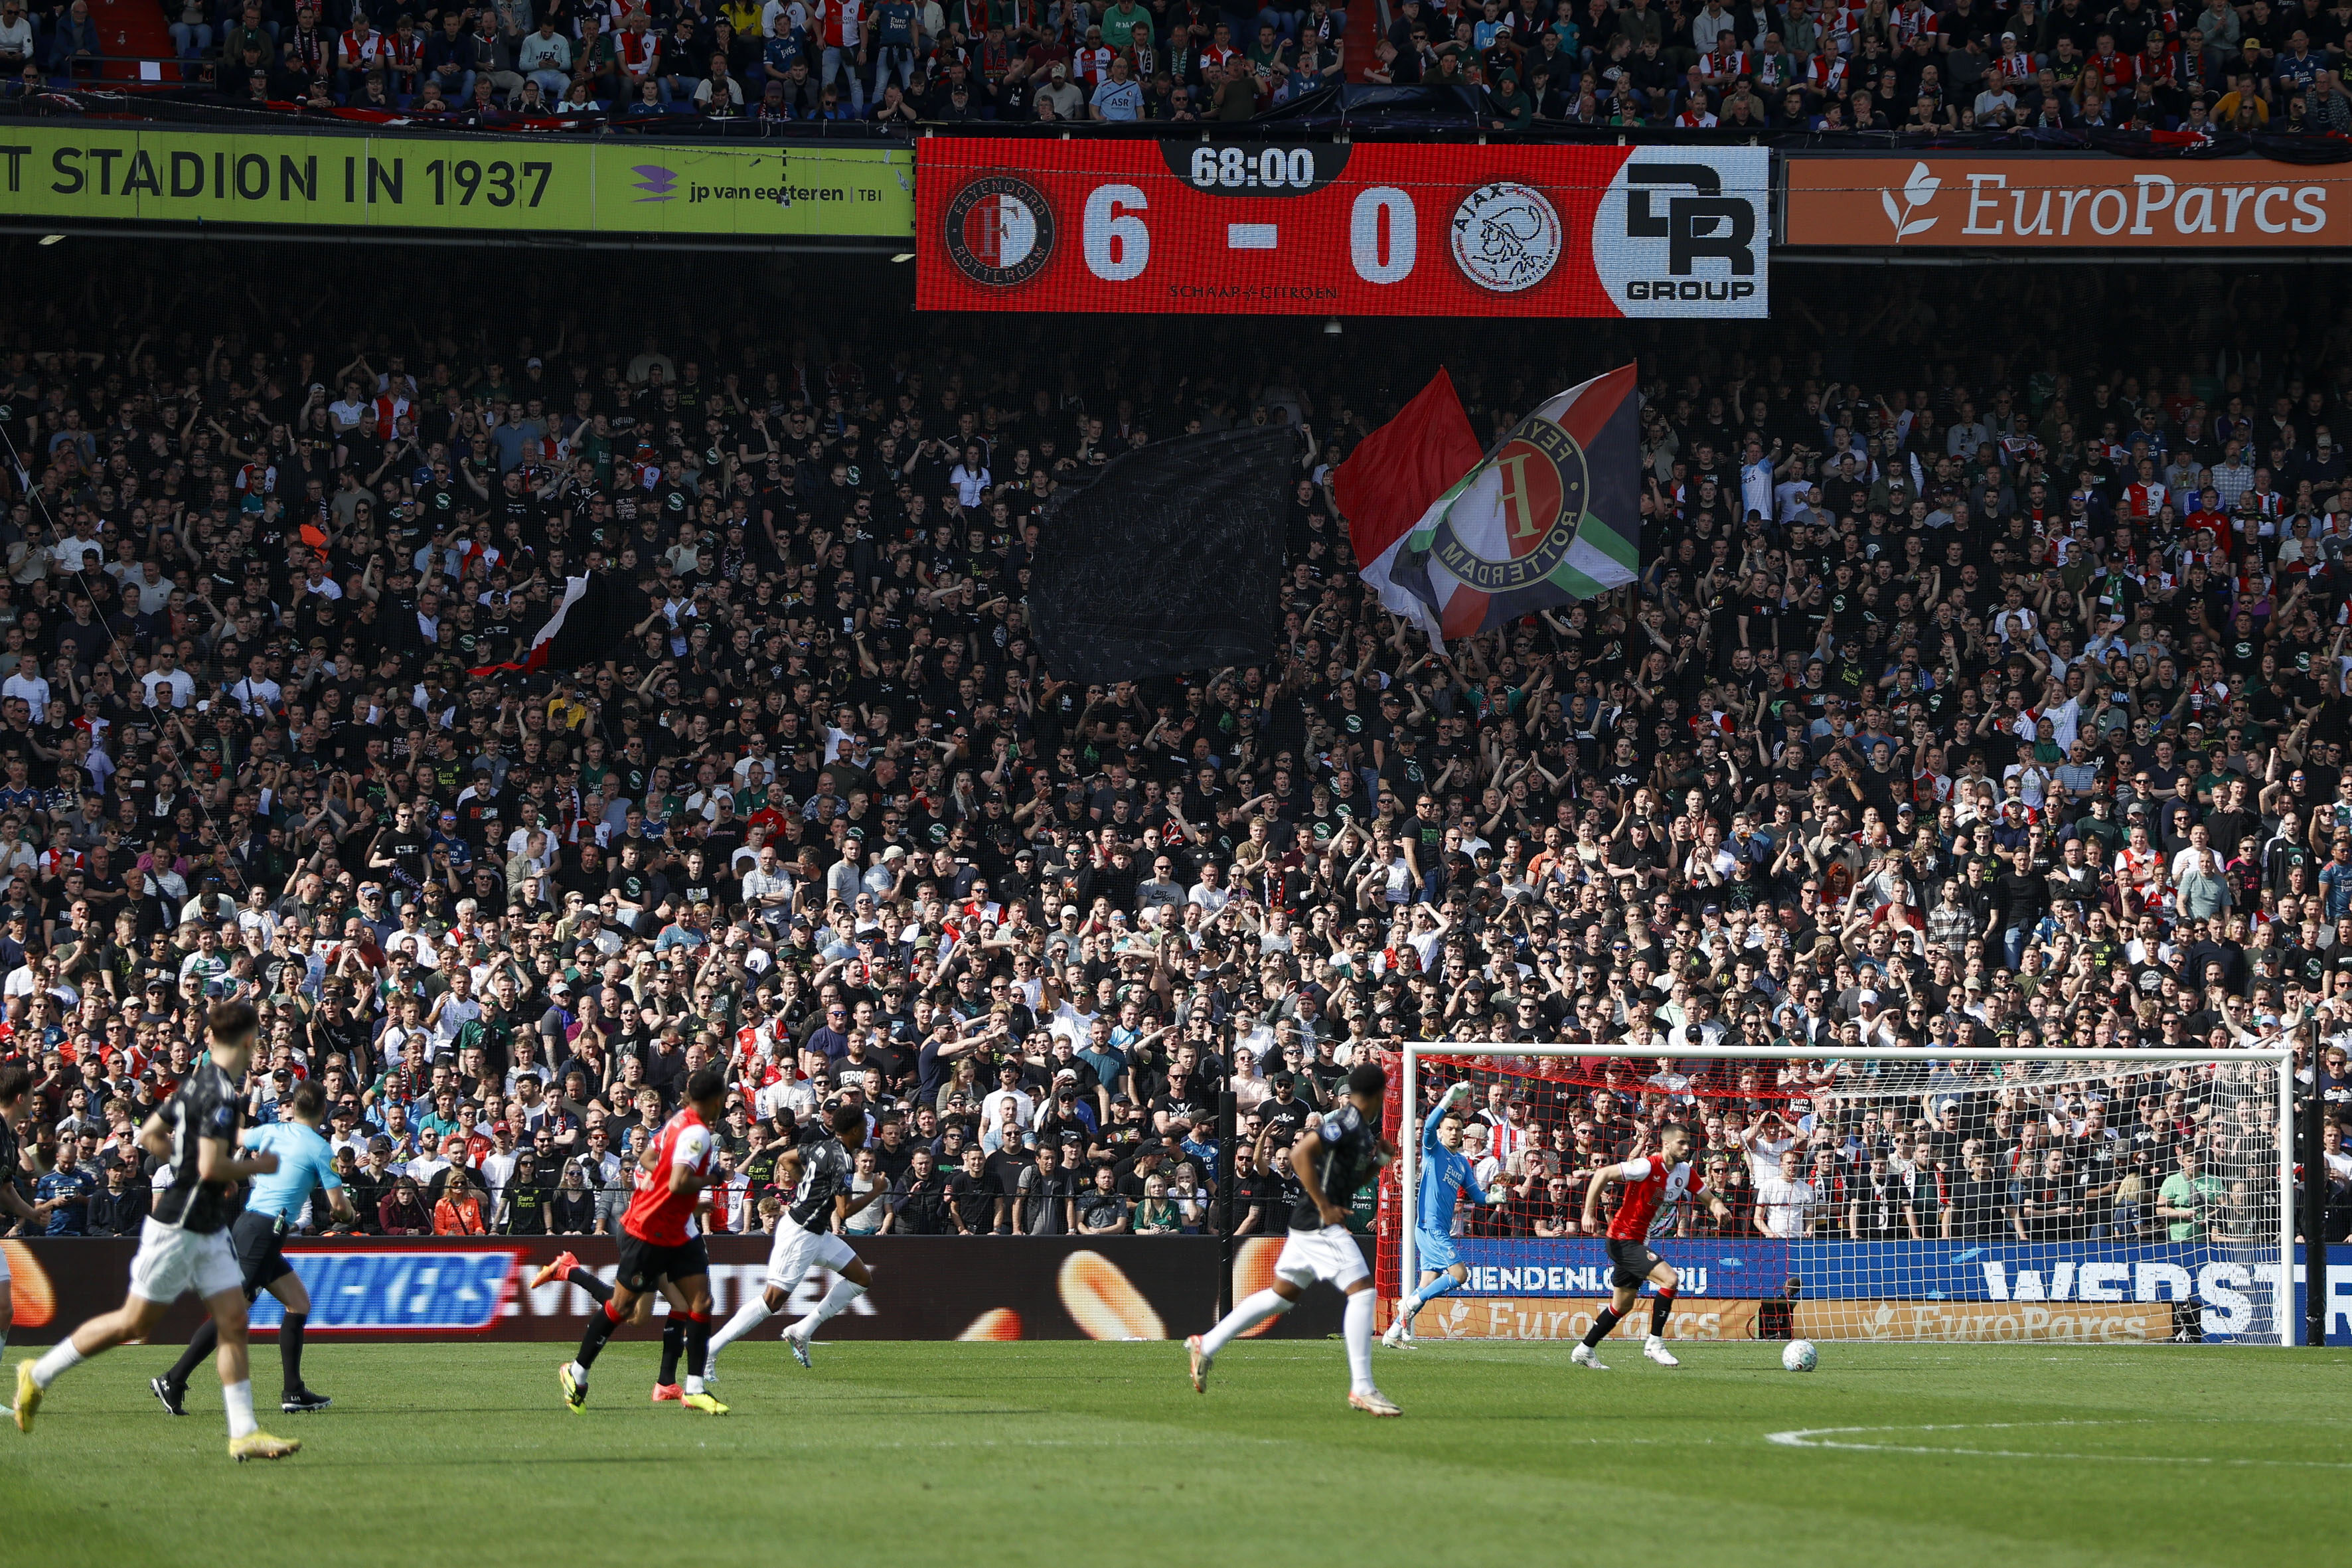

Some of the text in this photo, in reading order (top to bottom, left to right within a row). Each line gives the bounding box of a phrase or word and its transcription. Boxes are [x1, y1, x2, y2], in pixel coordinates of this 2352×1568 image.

[1111, 98, 1129, 107] ASR
[51, 147, 317, 201] STADION
[345, 156, 403, 204] IN
[426, 159, 552, 208] 1937
[1191, 147, 1314, 187] 68:00
[690, 182, 882, 203] jp van eeteren TBI
[955, 181, 1046, 215] FEYENOORD
[1454, 184, 1505, 232] AJAX
[1962, 173, 2327, 235] EuroParcs
[1083, 183, 1149, 281] 6
[1351, 185, 1417, 284] 0
[1169, 285, 1240, 298] SCHAAP
[1627, 281, 1755, 300] GROUP
[1446, 1164, 1462, 1180] Euro
[1486, 1302, 1720, 1340] Euroacs
